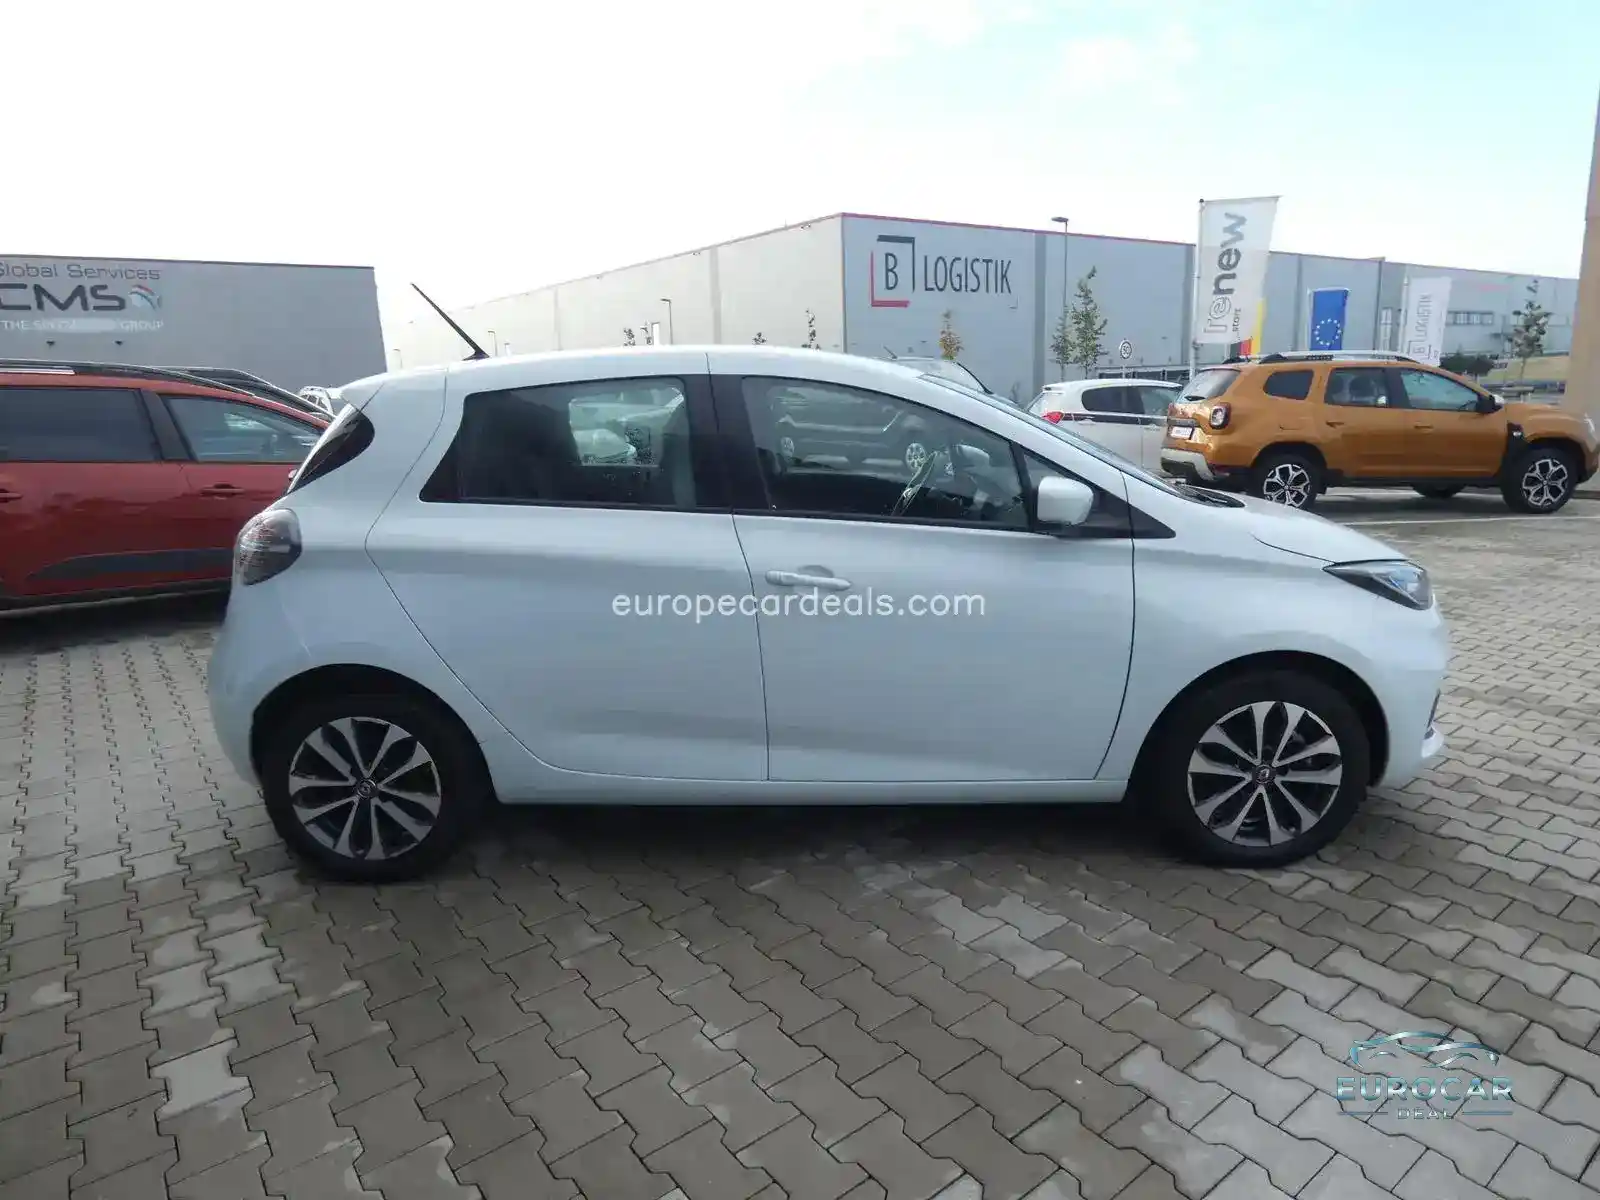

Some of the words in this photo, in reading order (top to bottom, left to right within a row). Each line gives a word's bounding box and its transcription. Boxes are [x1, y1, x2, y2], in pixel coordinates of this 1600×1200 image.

[67, 264, 161, 280] Services
[885, 252, 899, 291] B
[924, 255, 1012, 294] LOGISTIK
[0, 283, 126, 312] CMS
